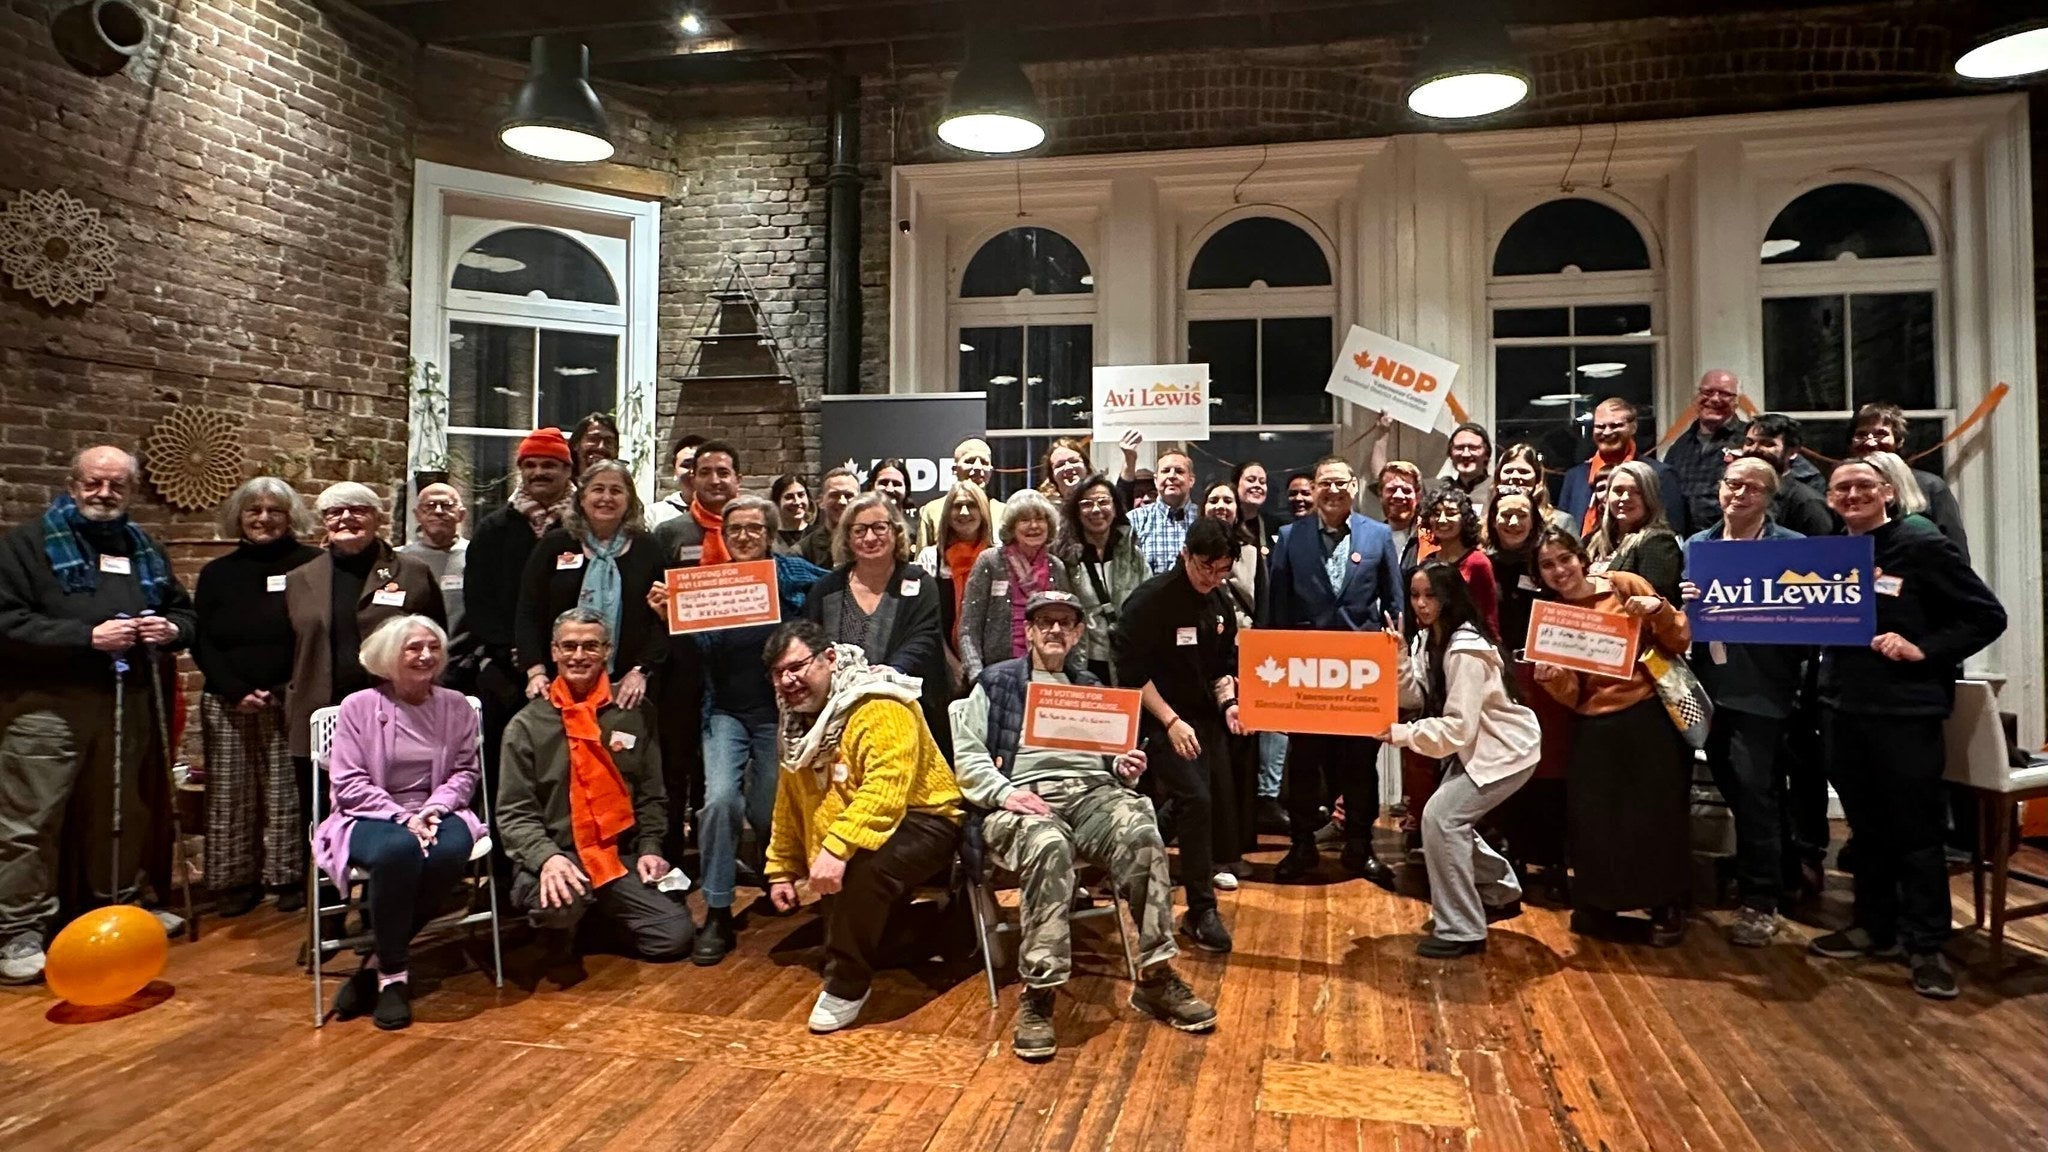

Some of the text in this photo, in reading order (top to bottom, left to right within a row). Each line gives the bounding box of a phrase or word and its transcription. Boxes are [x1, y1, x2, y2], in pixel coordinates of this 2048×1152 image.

[1372, 356, 1437, 393] NDP
[1103, 384, 1201, 407] Avi Lewis
[691, 570, 721, 580] VOTING
[722, 568, 738, 576] FOR
[677, 581, 692, 589] AVI
[693, 579, 717, 588] LEWIS
[1703, 573, 1861, 604] Avi Lewis
[1288, 657, 1381, 690] NDP
[1054, 689, 1085, 699] VOTING
[1087, 692, 1103, 700] FOR
[1297, 691, 1378, 703] Vancouver Centre
[1039, 698, 1054, 706] AVI
[1055, 699, 1080, 708] LEWIS
[1255, 700, 1293, 709] Electoral
